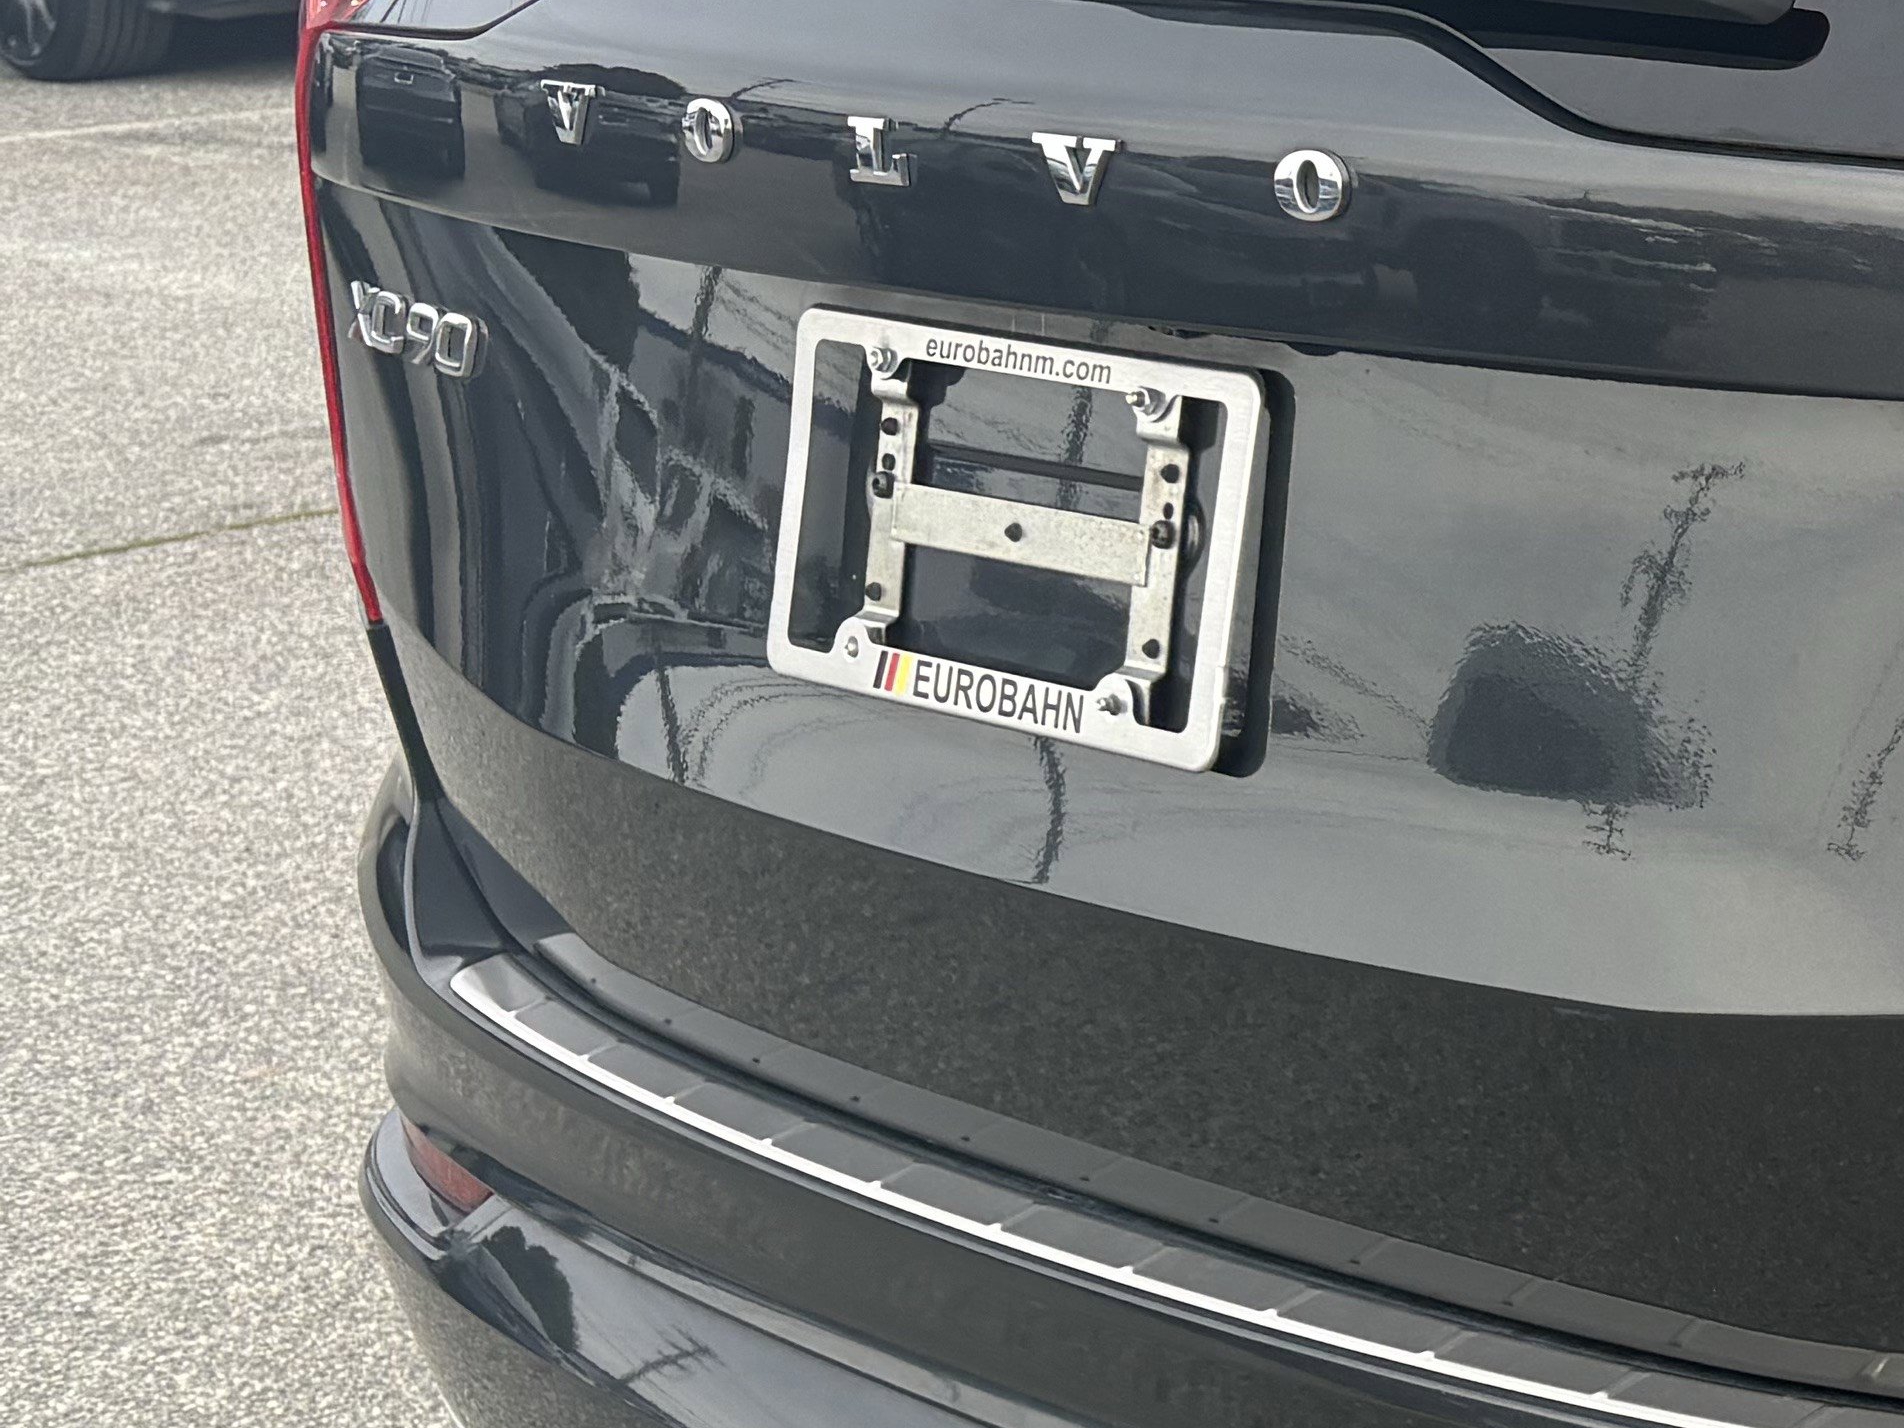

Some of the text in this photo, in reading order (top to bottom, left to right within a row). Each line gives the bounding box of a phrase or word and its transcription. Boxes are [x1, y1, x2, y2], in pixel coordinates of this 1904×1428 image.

[539, 78, 1351, 222] VOLVO
[347, 280, 484, 377] XC90
[925, 337, 1112, 385] eurobahnm.com
[912, 658, 1085, 734] EUROBAHN
